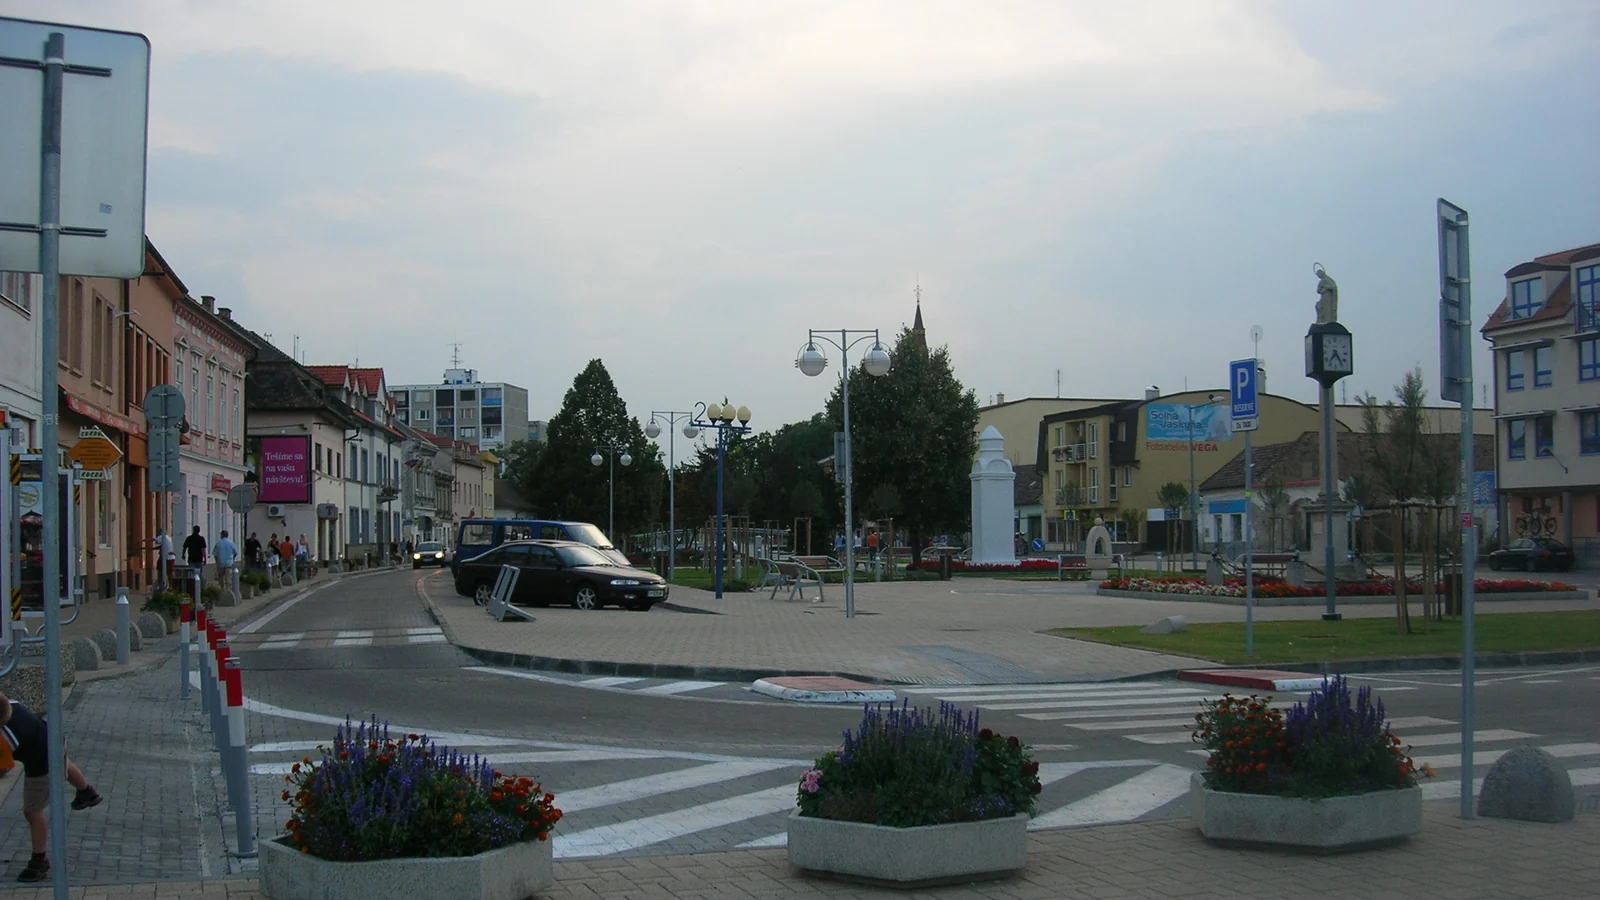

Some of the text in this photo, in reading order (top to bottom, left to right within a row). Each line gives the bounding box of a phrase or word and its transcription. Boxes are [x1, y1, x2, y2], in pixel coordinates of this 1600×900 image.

[1237, 367, 1249, 399] P
[1191, 443, 1218, 452] VEGA
[265, 452, 303, 461] Tešíme sa
[277, 464, 295, 472] vašu
